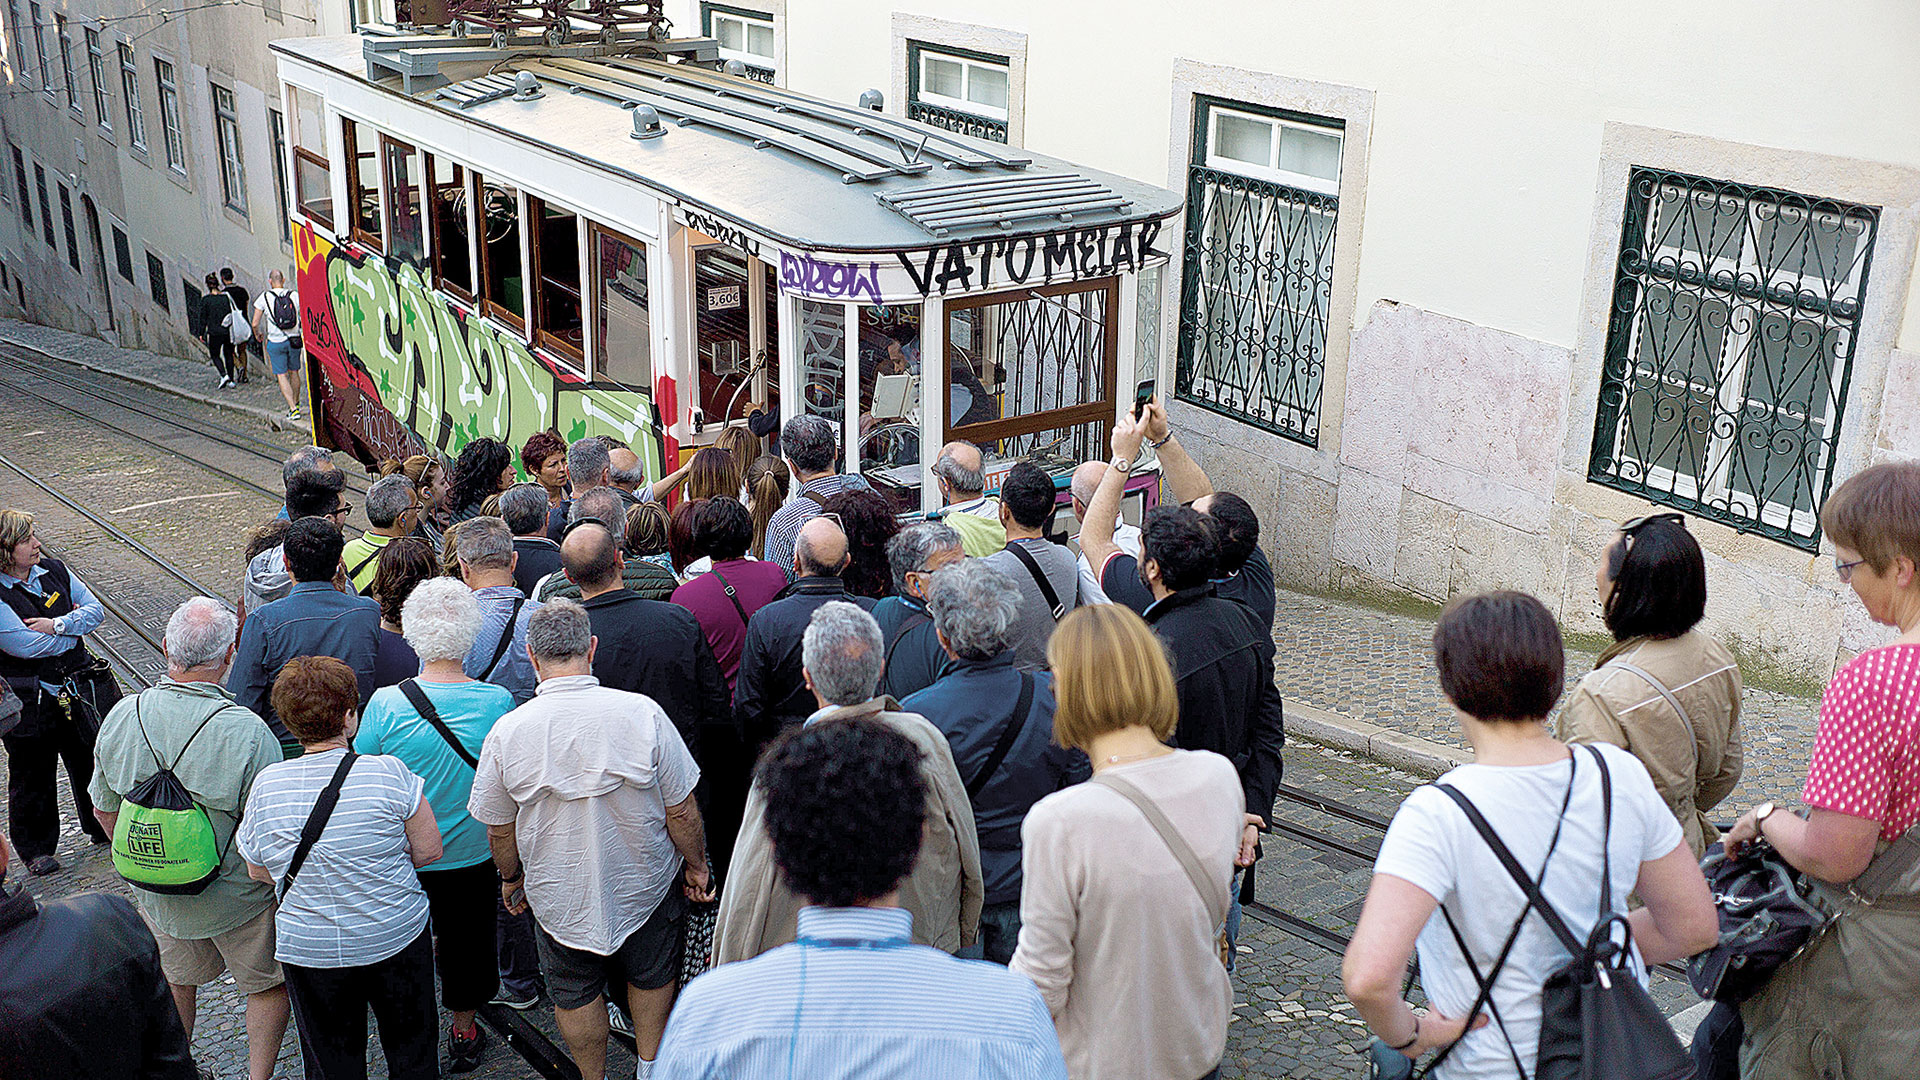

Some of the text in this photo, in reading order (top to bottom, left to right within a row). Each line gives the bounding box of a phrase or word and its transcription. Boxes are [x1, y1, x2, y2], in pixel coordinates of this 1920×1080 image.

[709, 292, 739, 306] 3,60€
[130, 825, 159, 836] DONATE
[130, 839, 162, 855] LIFE
